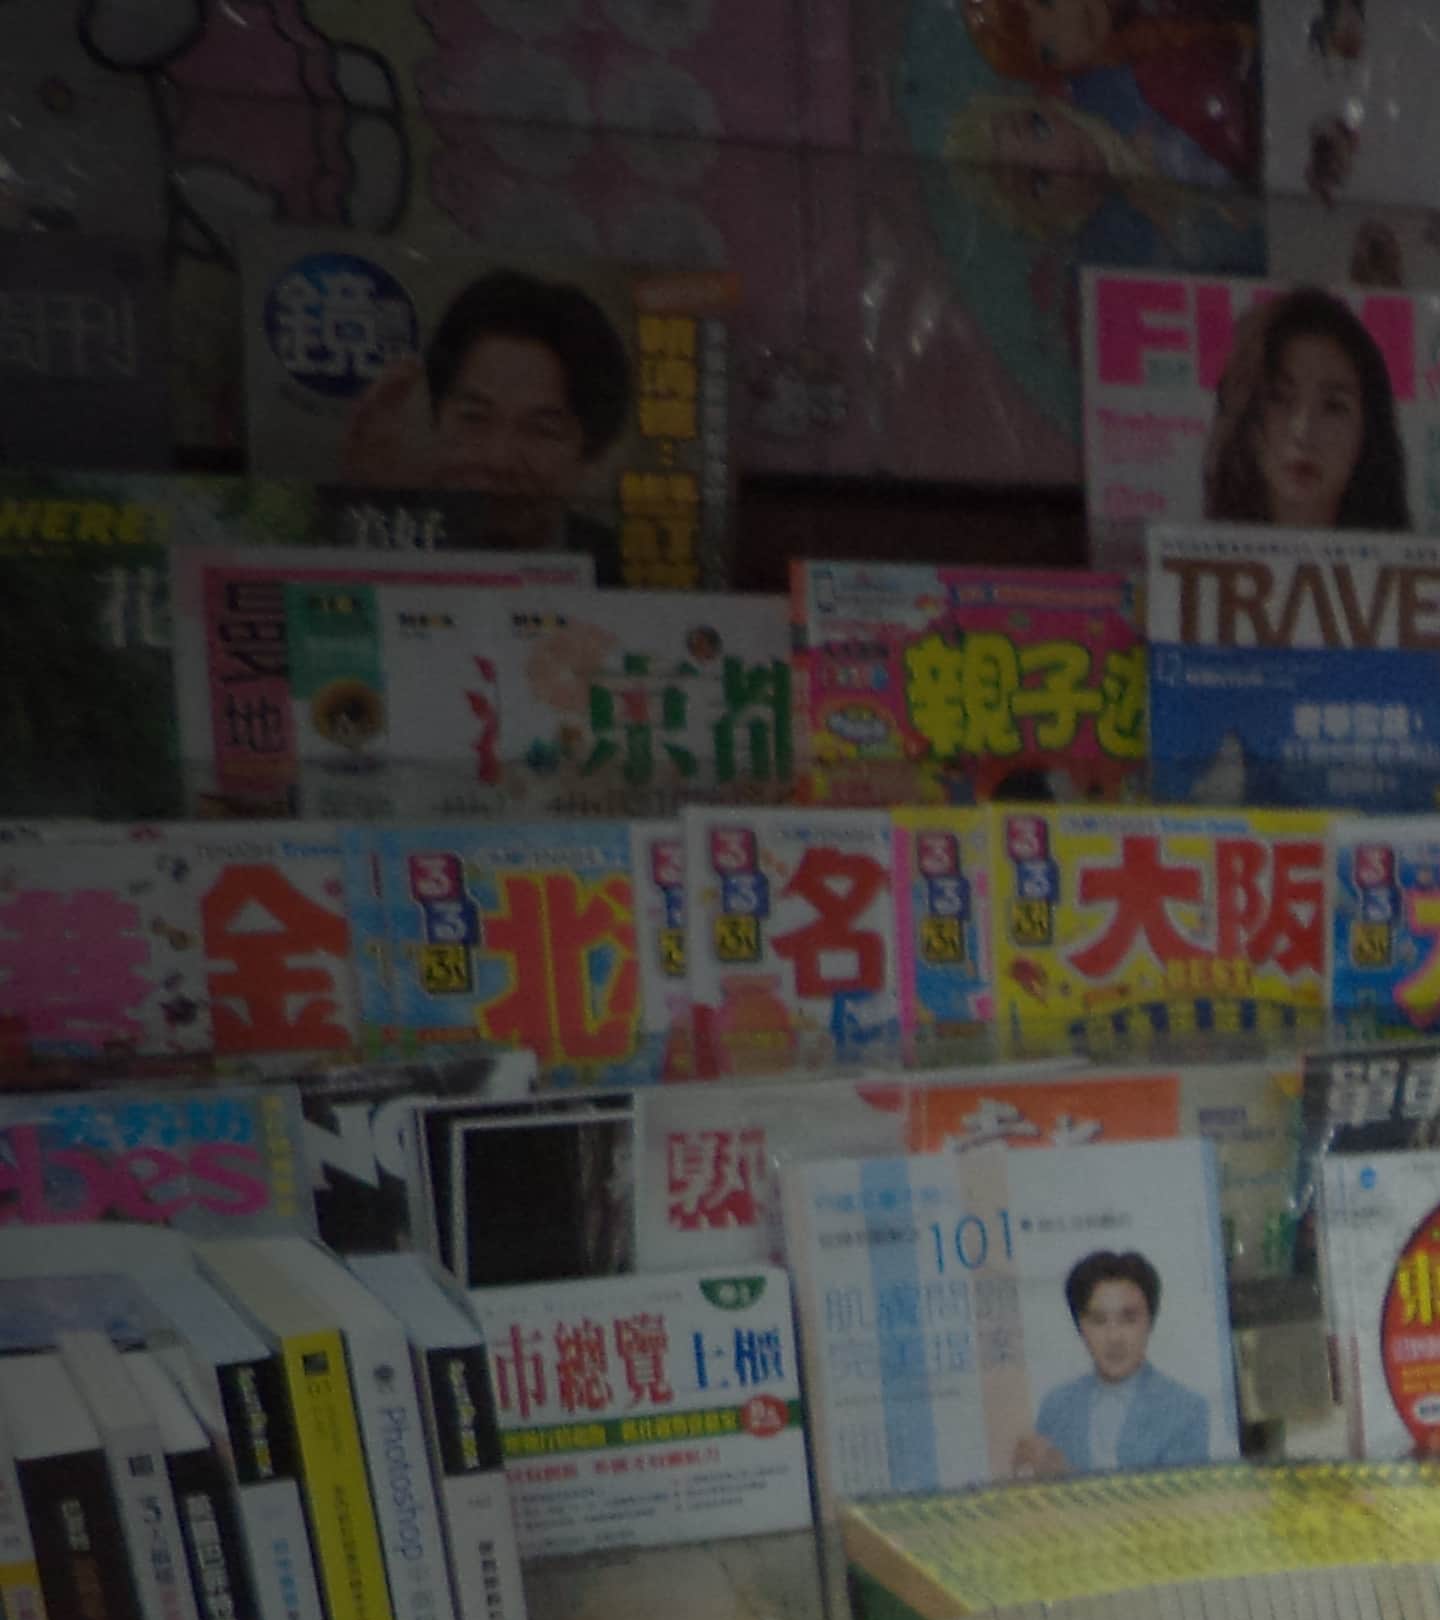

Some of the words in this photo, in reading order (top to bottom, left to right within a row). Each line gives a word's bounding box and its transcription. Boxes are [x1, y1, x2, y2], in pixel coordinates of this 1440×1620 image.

[200, 862, 352, 1052] 金
[480, 870, 640, 1066] 北
[770, 845, 890, 998] 名
[1068, 832, 1328, 980] 大阪
[926, 1208, 1016, 1273] 101
[500, 1312, 676, 1417] 市總覽
[377, 1405, 427, 1562] Photoshop
